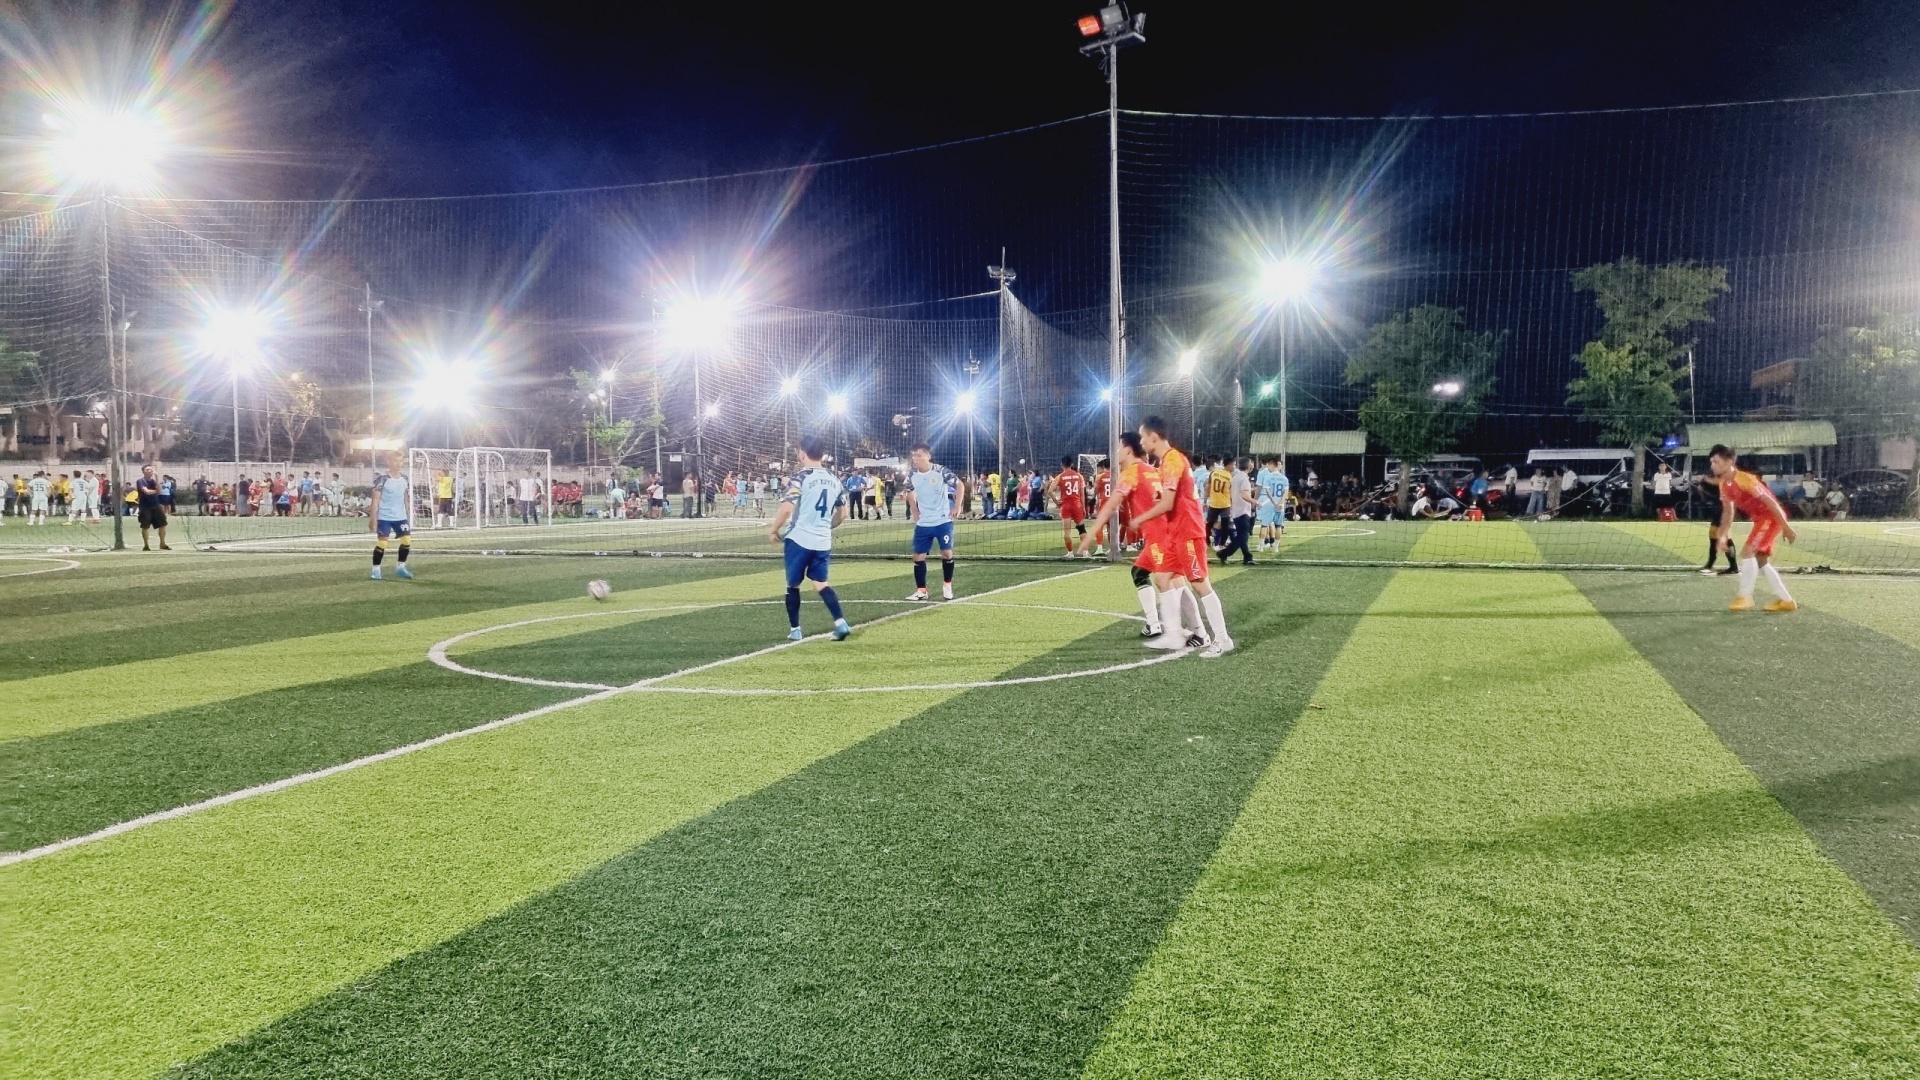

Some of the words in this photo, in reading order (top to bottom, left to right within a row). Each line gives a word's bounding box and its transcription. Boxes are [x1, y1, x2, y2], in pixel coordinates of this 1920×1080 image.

[1064, 481, 1079, 496] 34
[1271, 482, 1284, 498] 18
[814, 488, 828, 518] 4
[943, 534, 950, 544] 9
